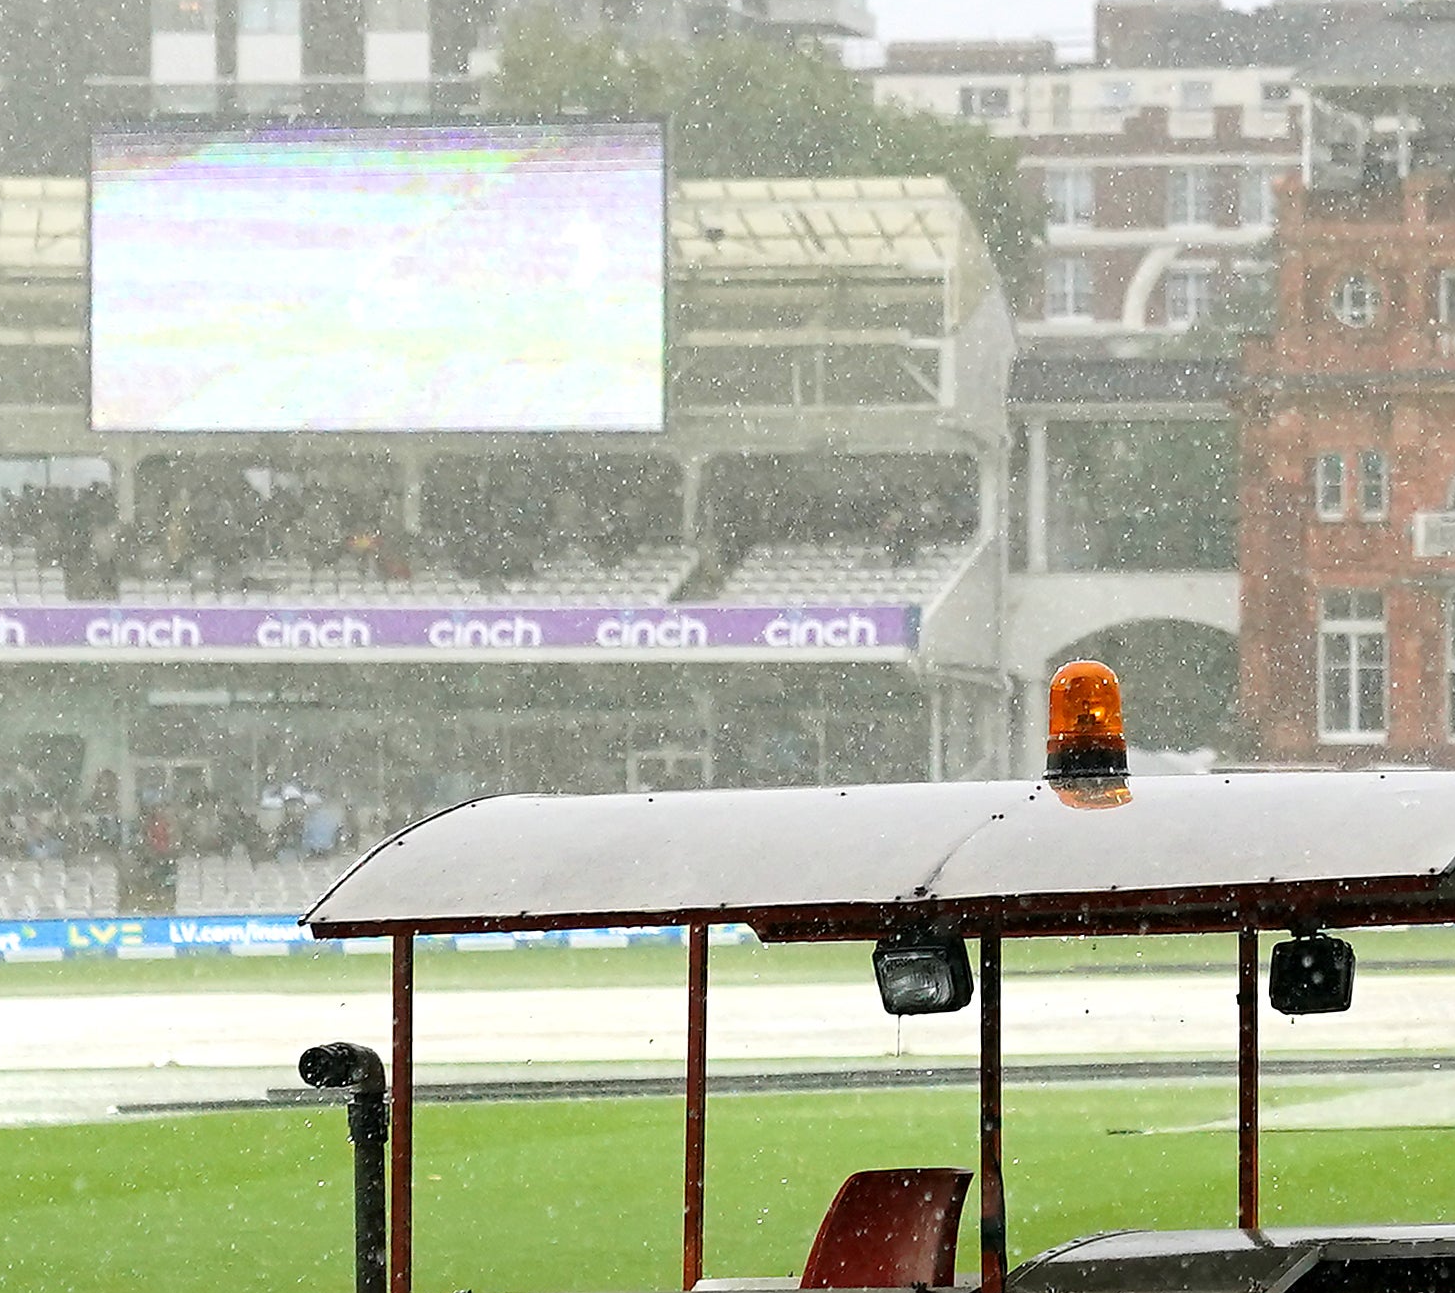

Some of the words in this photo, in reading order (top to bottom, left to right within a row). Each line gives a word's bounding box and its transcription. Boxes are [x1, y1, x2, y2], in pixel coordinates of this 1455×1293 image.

[86, 611, 202, 648] cinch
[256, 611, 372, 648] cinch
[428, 611, 542, 648] cinch
[595, 611, 709, 648] cinch
[763, 611, 878, 648] cinch
